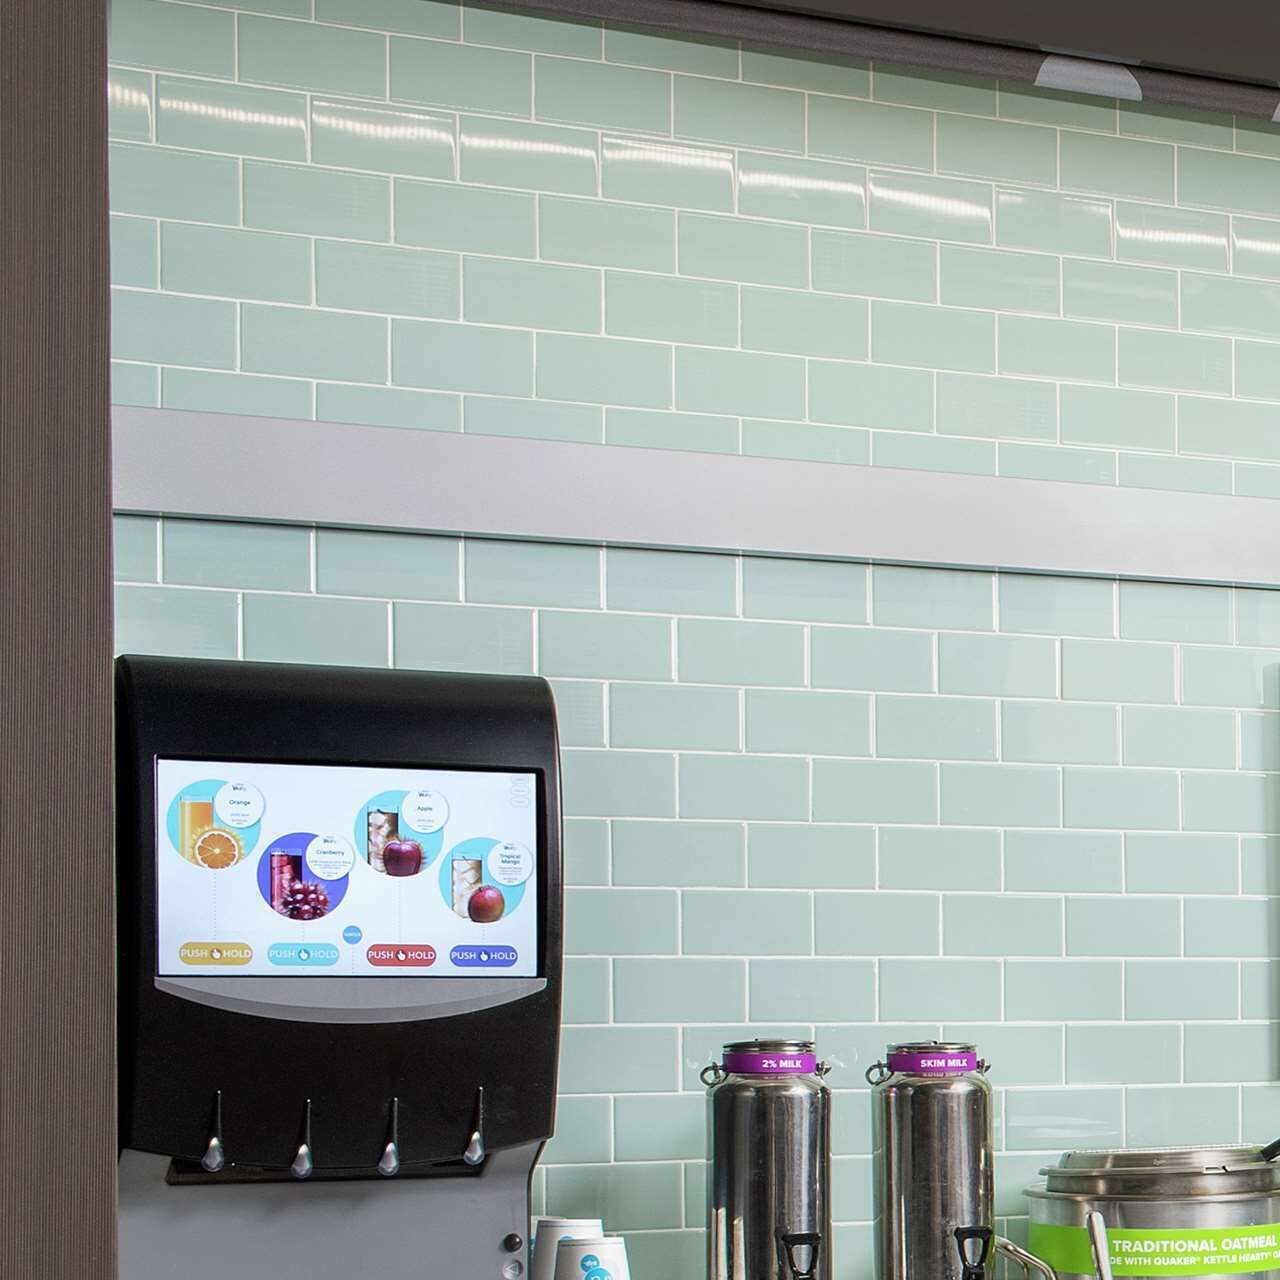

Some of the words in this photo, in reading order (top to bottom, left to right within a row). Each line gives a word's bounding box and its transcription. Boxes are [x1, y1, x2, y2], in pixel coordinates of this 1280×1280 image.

[180, 949, 208, 959] PUSH
[223, 950, 251, 959] HOLD
[269, 950, 295, 959] PUSH
[311, 950, 338, 959] HOLD
[368, 951, 392, 960] PUSH
[407, 951, 435, 960] HOLD
[451, 951, 476, 961] PUSH
[490, 951, 517, 961] HOLD
[762, 1060, 777, 1068] 2%
[779, 1060, 802, 1068] MILK
[920, 1059, 945, 1068] SKIM
[948, 1058, 967, 1067] MILK
[1112, 1240, 1218, 1253] TRADITIONAL
[1221, 1234, 1277, 1250] OATMEAL
[1124, 1257, 1151, 1265] WITH
[1204, 1255, 1236, 1264] KETTLE
